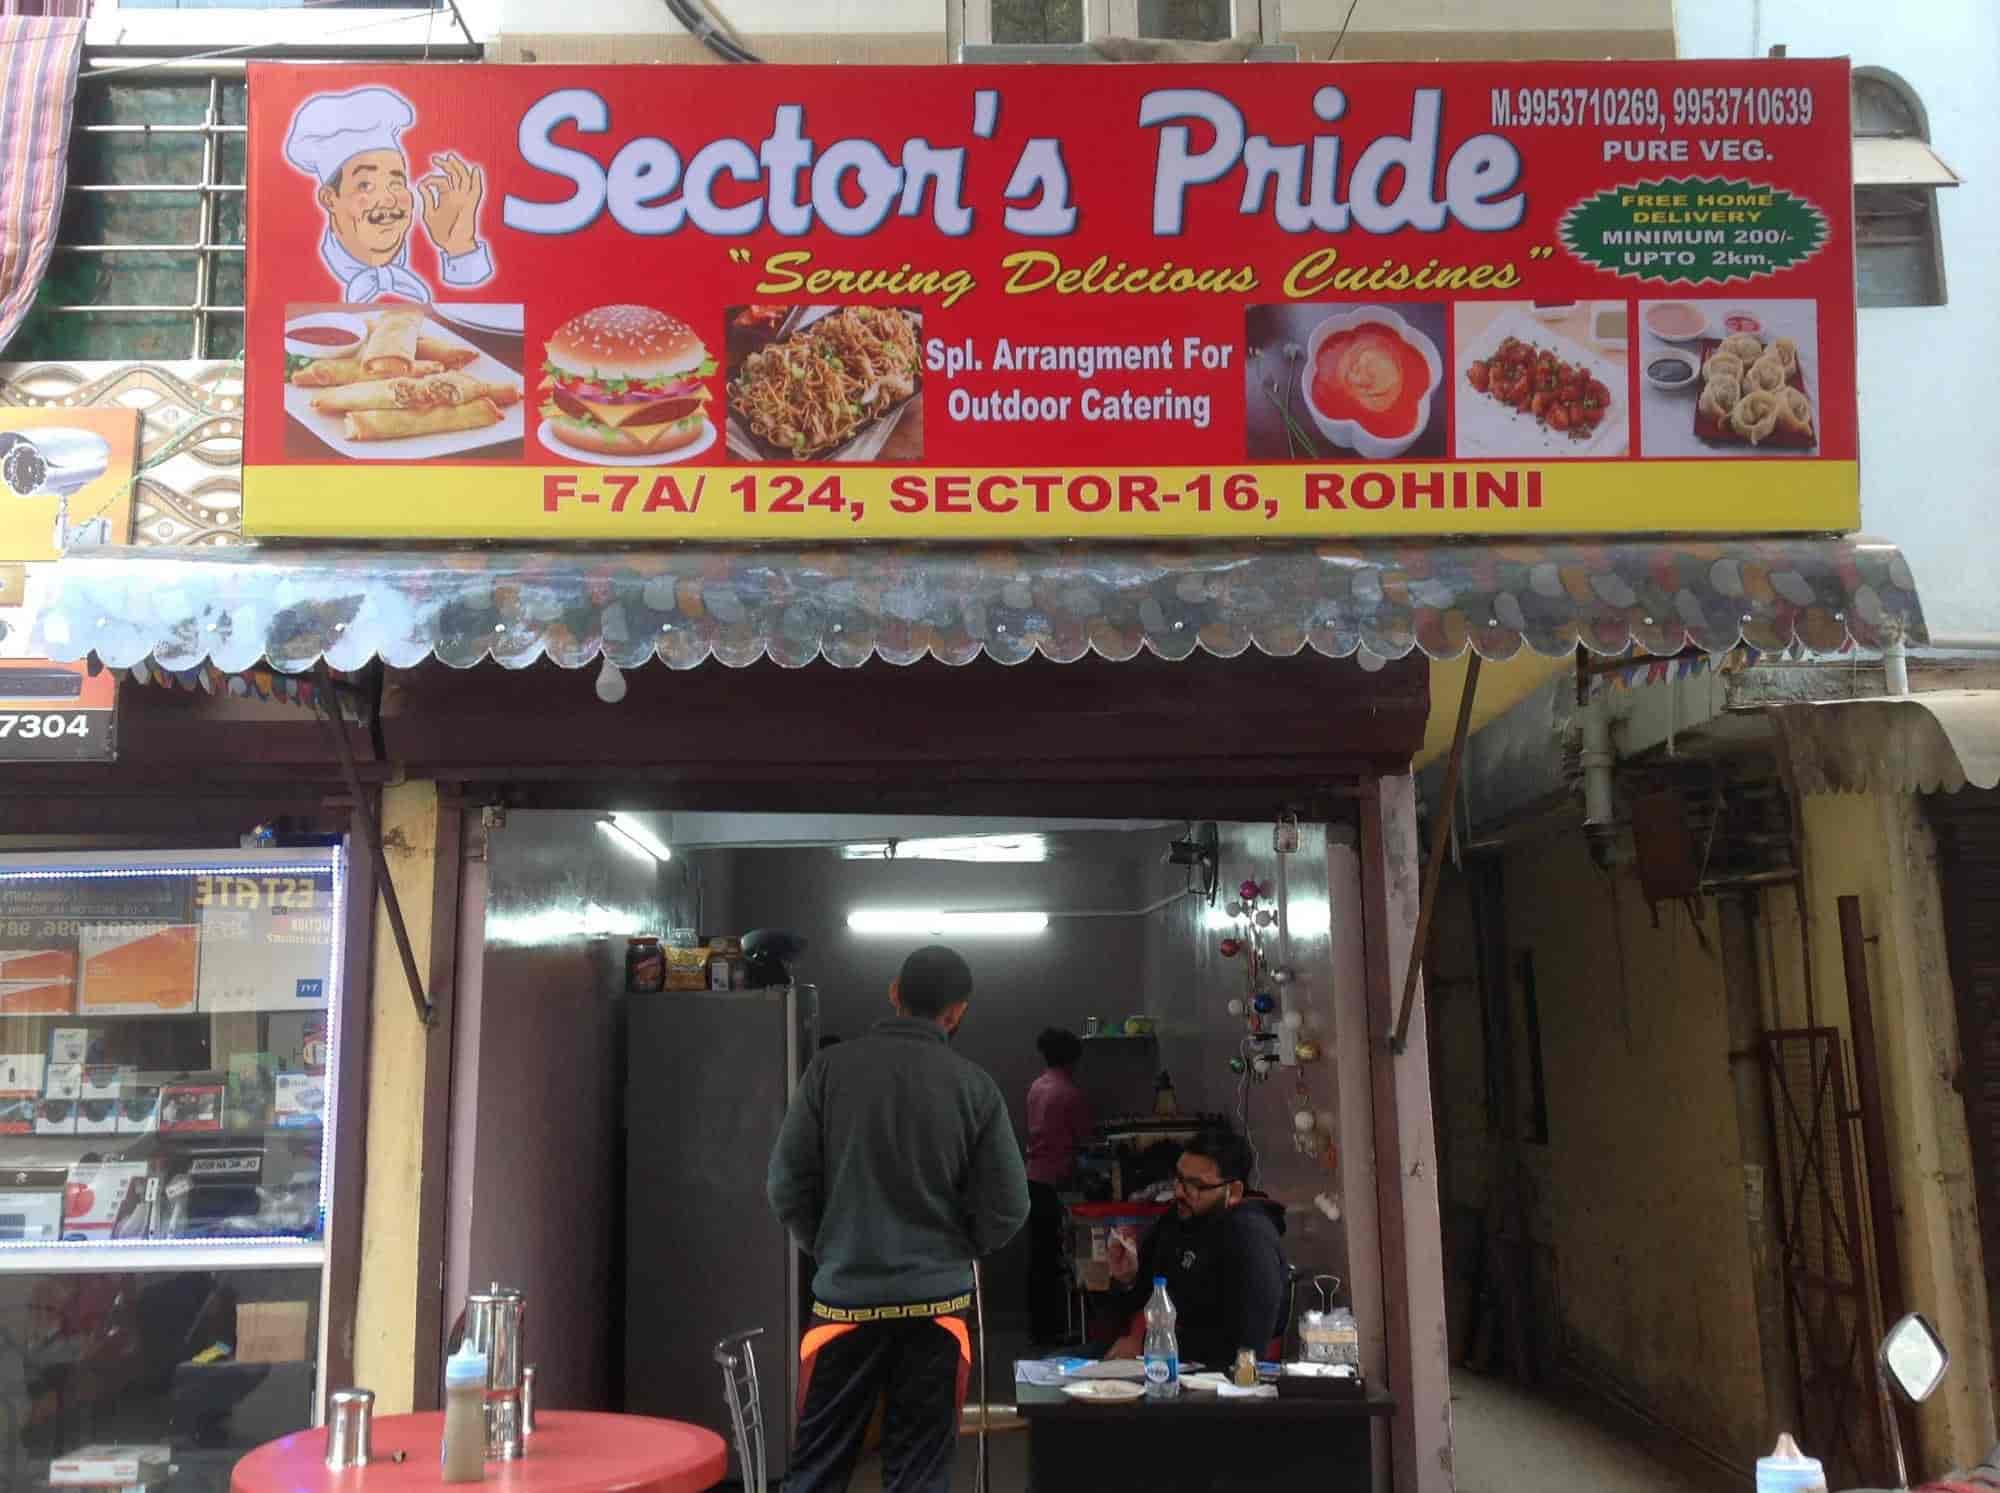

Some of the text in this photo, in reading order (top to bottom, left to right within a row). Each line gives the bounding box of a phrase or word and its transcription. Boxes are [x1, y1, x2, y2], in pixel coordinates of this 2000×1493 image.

[1490, 86, 1814, 134] M.9953710269, 9953710639
[503, 86, 1526, 237] Sector's Pride
[1603, 139, 1775, 163] PURE VEG.
[1621, 194, 1774, 207] FREE HOME
[1632, 211, 1763, 224] DELIVERY
[1602, 229, 1794, 245] MINIMUM 200/-
[1001, 250, 1260, 297] Delicious
[1623, 251, 1774, 266] UPTO 2km.
[926, 336, 1234, 379] Spl. Arrangment For
[948, 386, 1211, 428] Outdoor Catering
[541, 470, 1544, 521] F-7A/ 124, SECTOR-16, ROHINI
